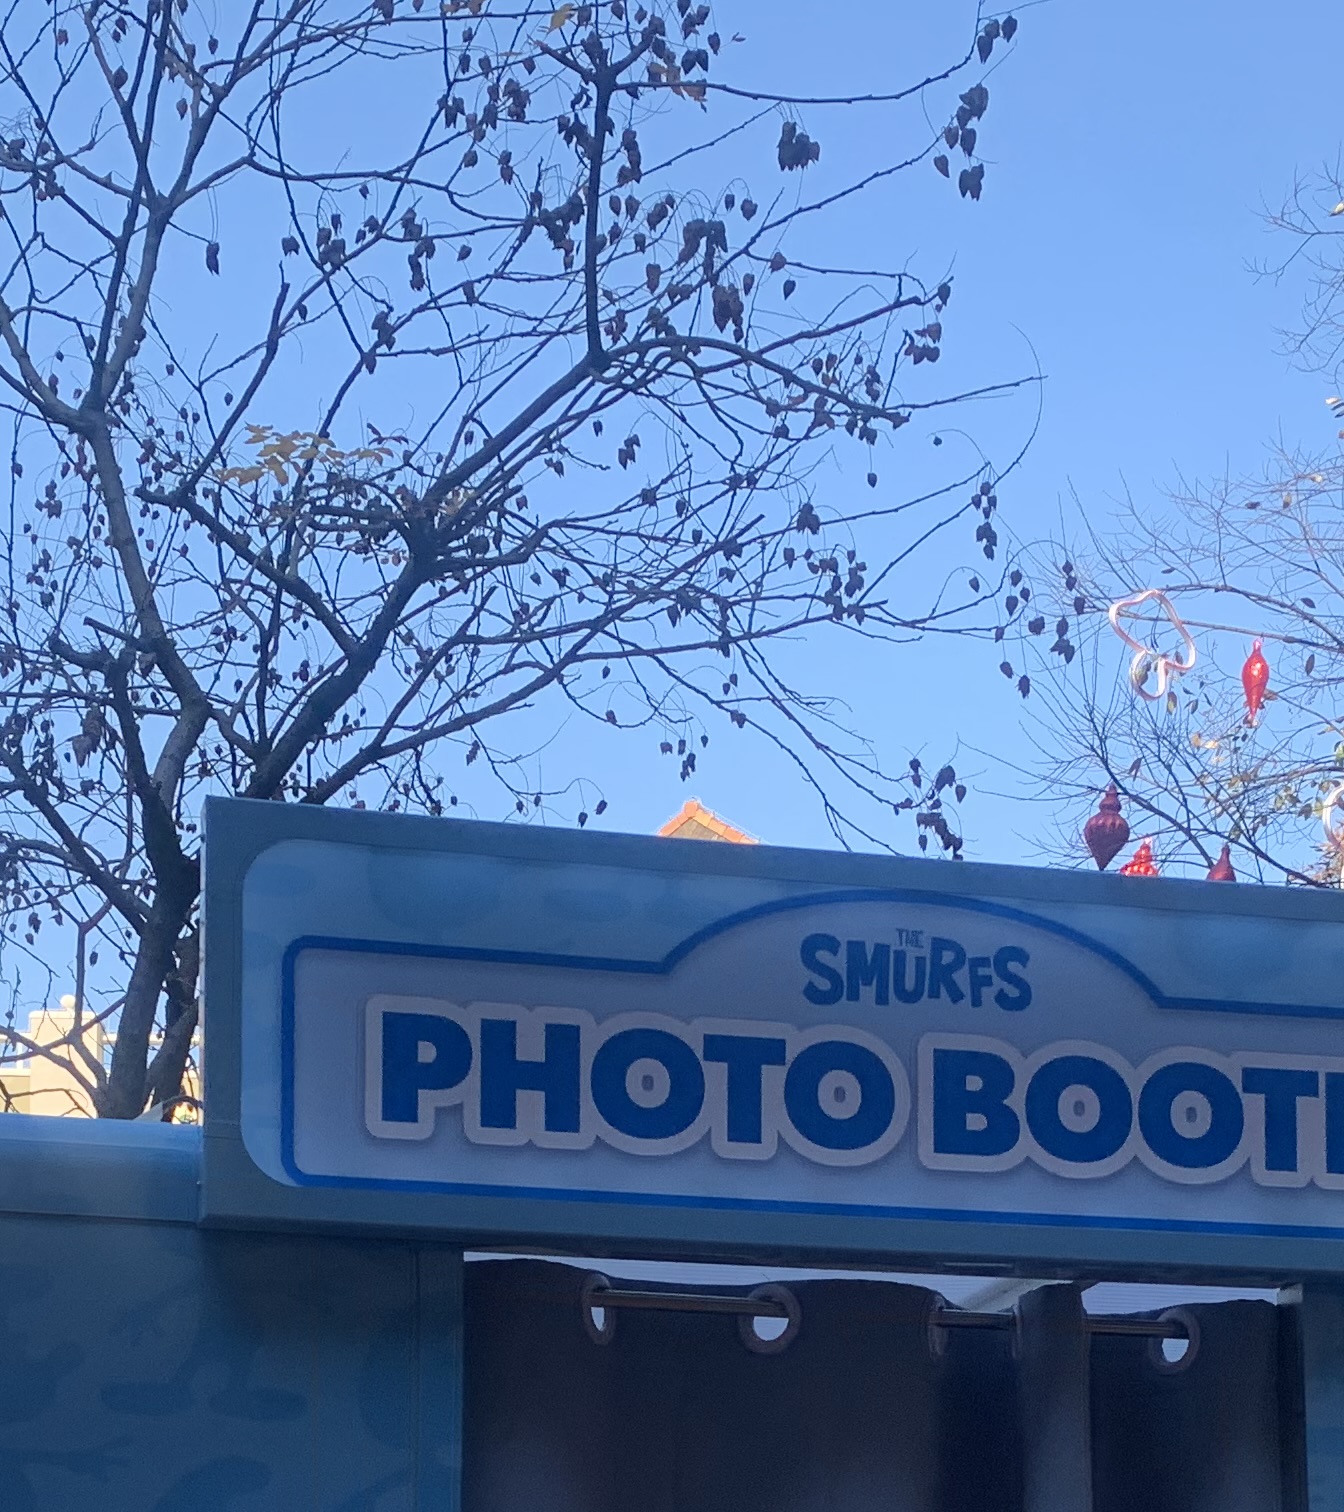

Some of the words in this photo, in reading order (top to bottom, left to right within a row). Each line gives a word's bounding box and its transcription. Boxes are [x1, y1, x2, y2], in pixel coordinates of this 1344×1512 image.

[799, 932, 1032, 1012] SMURFS
[895, 927, 924, 949] THE
[374, 1007, 901, 1158] PHOTO
